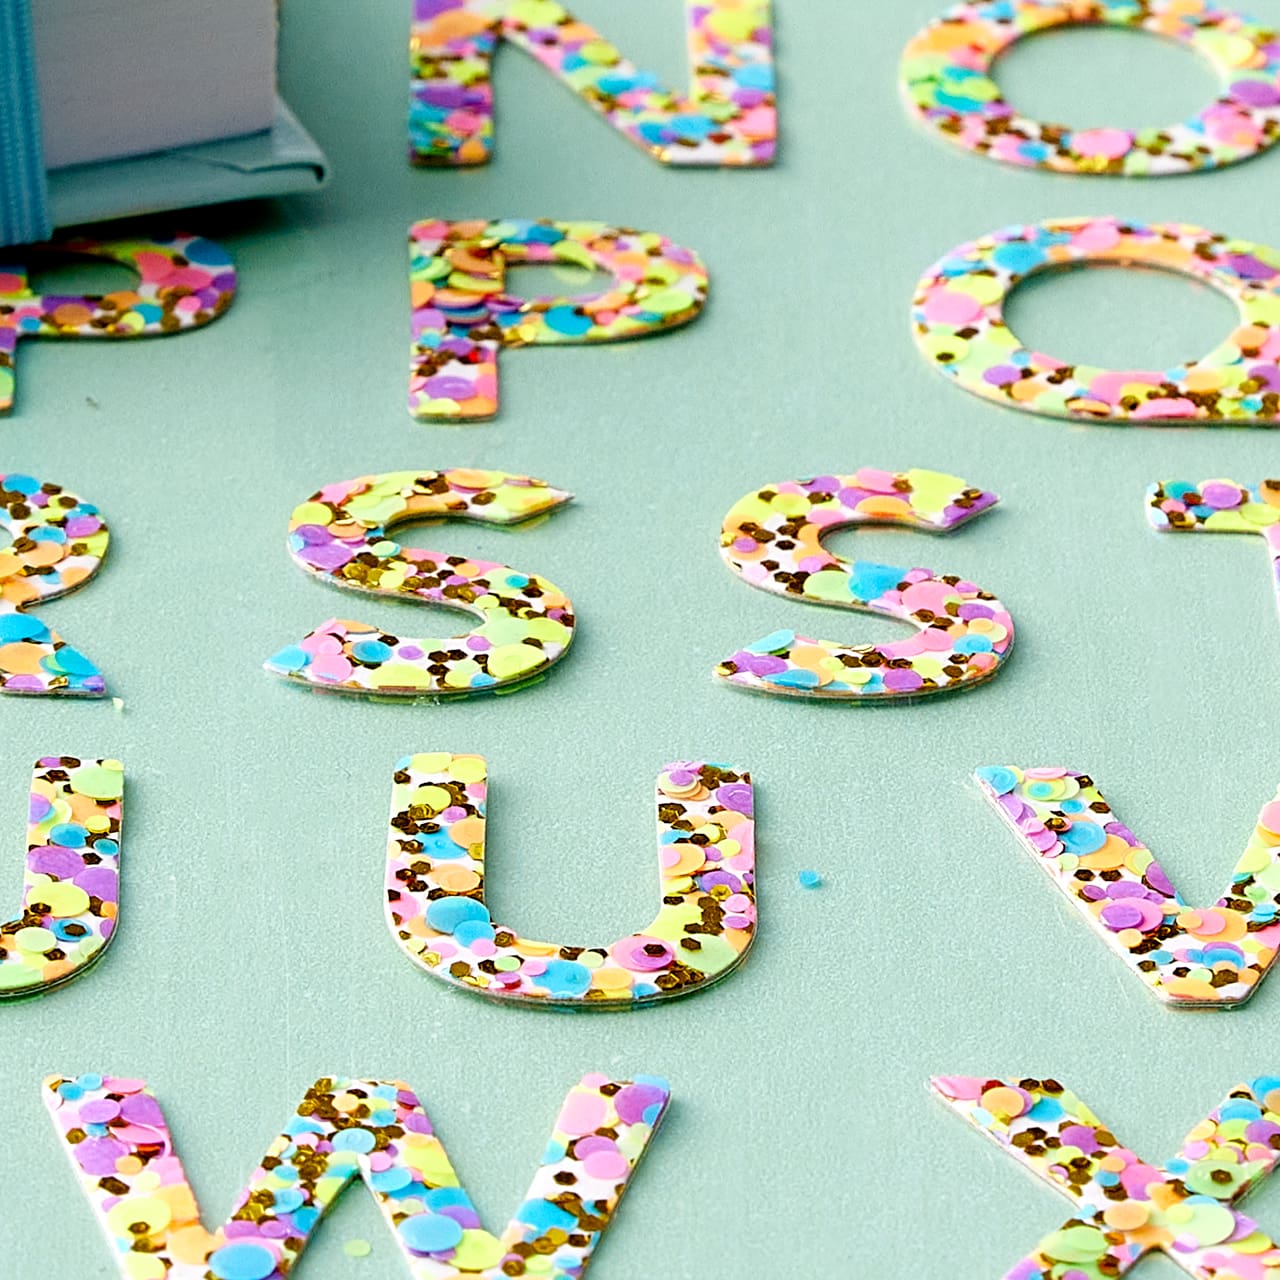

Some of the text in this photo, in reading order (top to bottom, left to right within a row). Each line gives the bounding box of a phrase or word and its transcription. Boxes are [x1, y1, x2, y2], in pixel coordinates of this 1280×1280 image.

[407, 218, 712, 422] P
[263, 468, 578, 700] S
[712, 468, 1016, 700] S
[385, 752, 757, 1008] U
